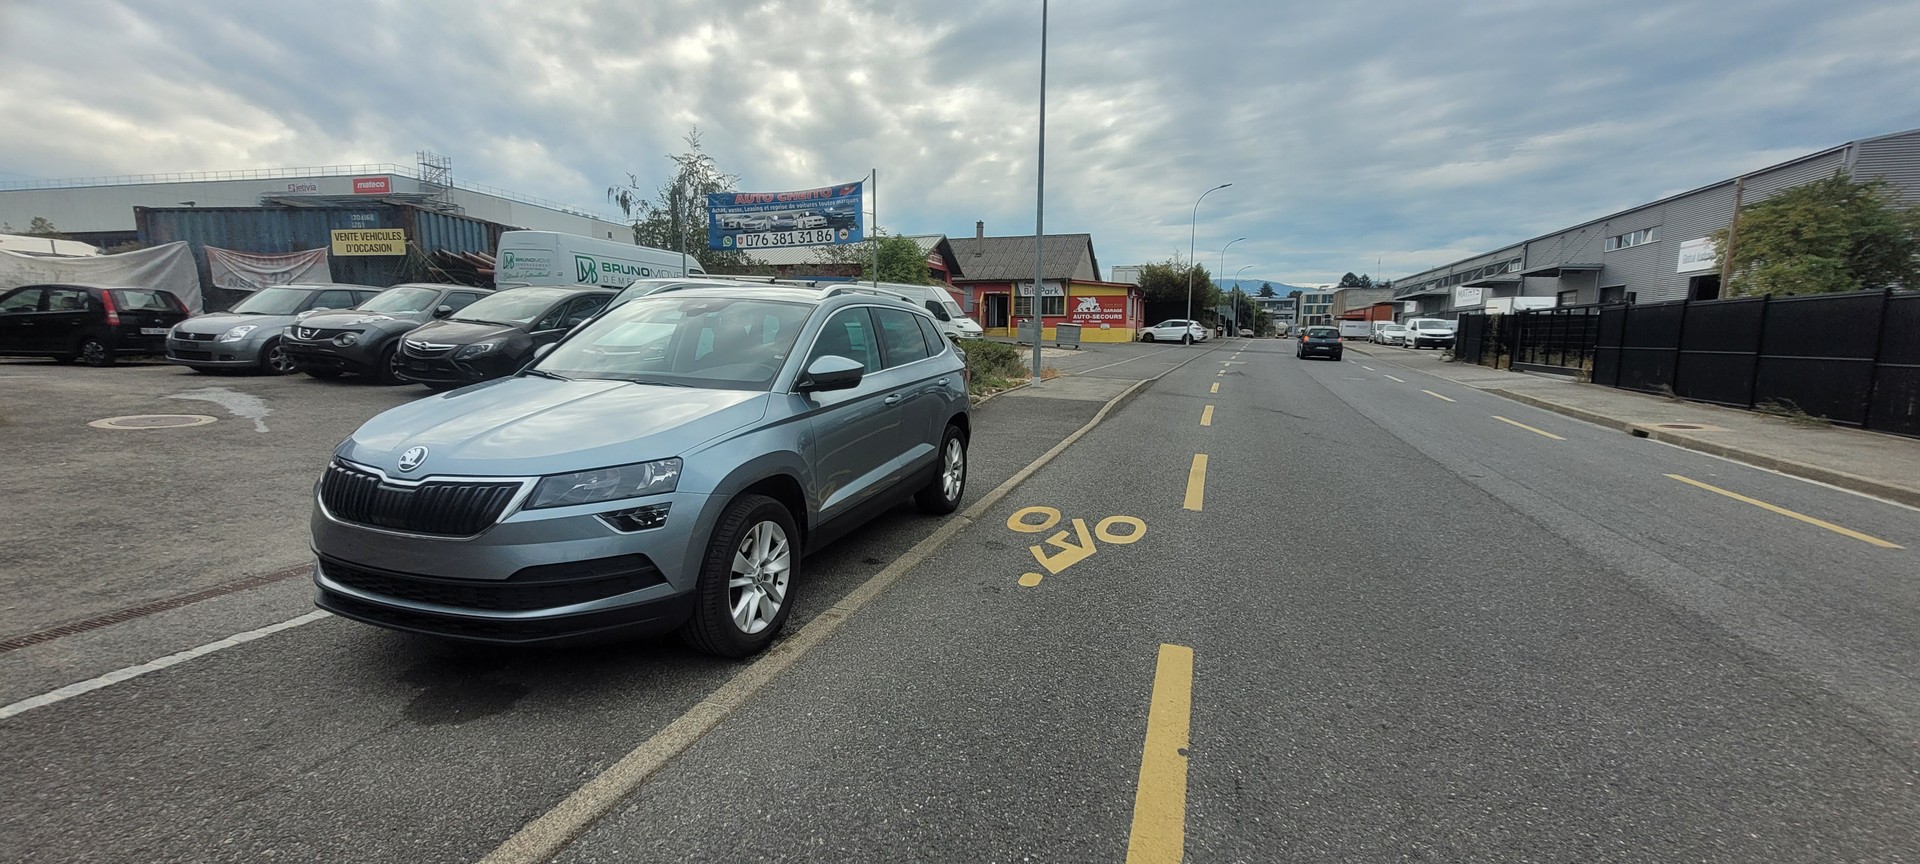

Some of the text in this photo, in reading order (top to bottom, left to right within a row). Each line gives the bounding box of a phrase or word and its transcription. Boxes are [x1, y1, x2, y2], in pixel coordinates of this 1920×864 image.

[357, 180, 385, 189] mateco
[734, 192, 774, 204] AUTO
[770, 203, 788, 211] reprise
[836, 197, 859, 205] marques
[334, 232, 402, 241] VENTE VEHICULES
[746, 229, 833, 247] 076 381 31 86
[346, 243, 392, 253] D'OCCASION
